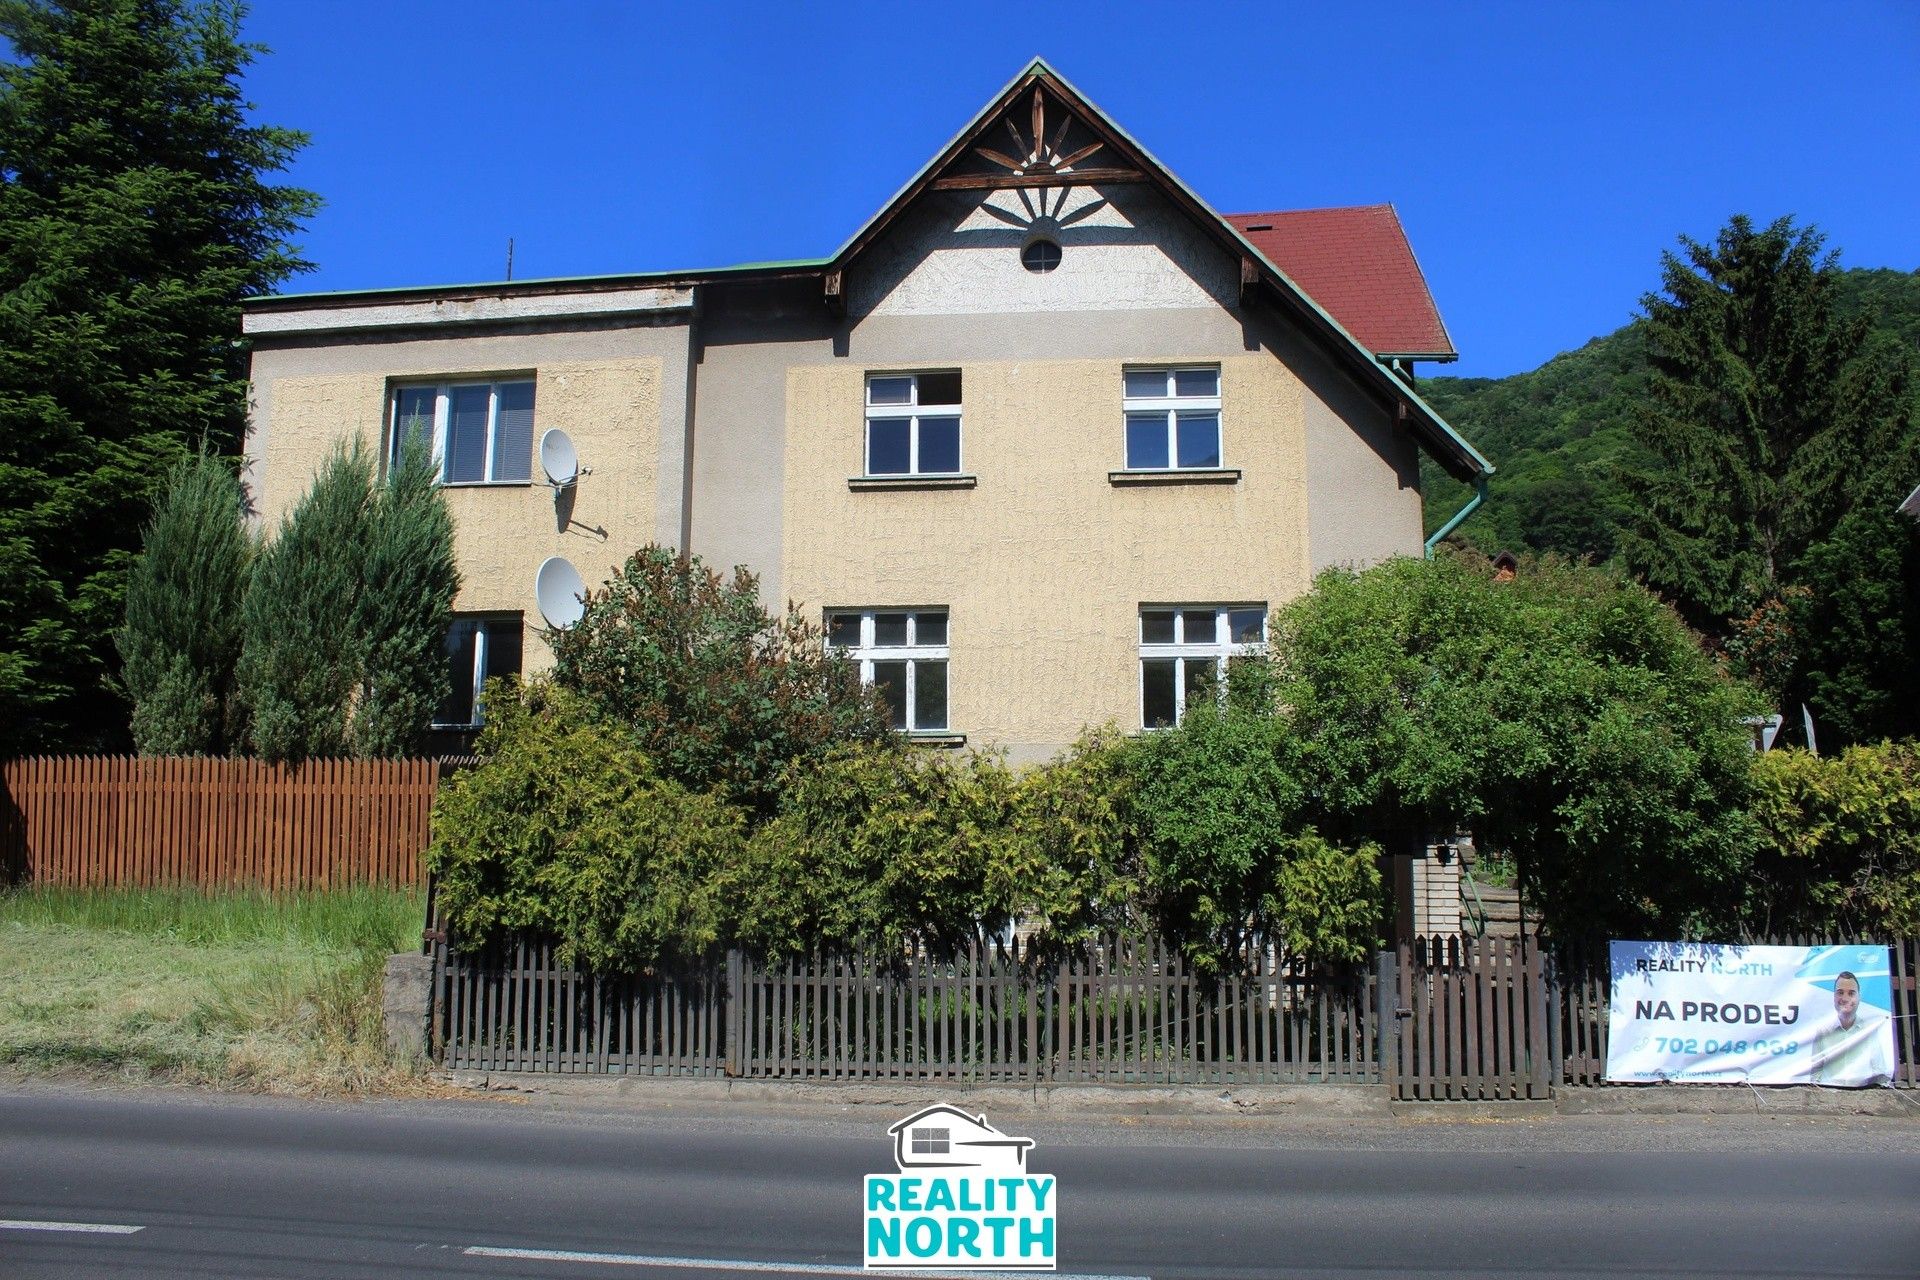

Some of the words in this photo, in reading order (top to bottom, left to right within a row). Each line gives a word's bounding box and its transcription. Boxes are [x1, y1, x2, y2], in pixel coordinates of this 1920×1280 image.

[1636, 959, 1707, 973] REALITY
[1635, 1000, 1675, 1020] NA
[1682, 1002, 1799, 1025] PRODEJ
[1655, 1037, 1698, 1055] 702
[1705, 1039, 1748, 1055] 048
